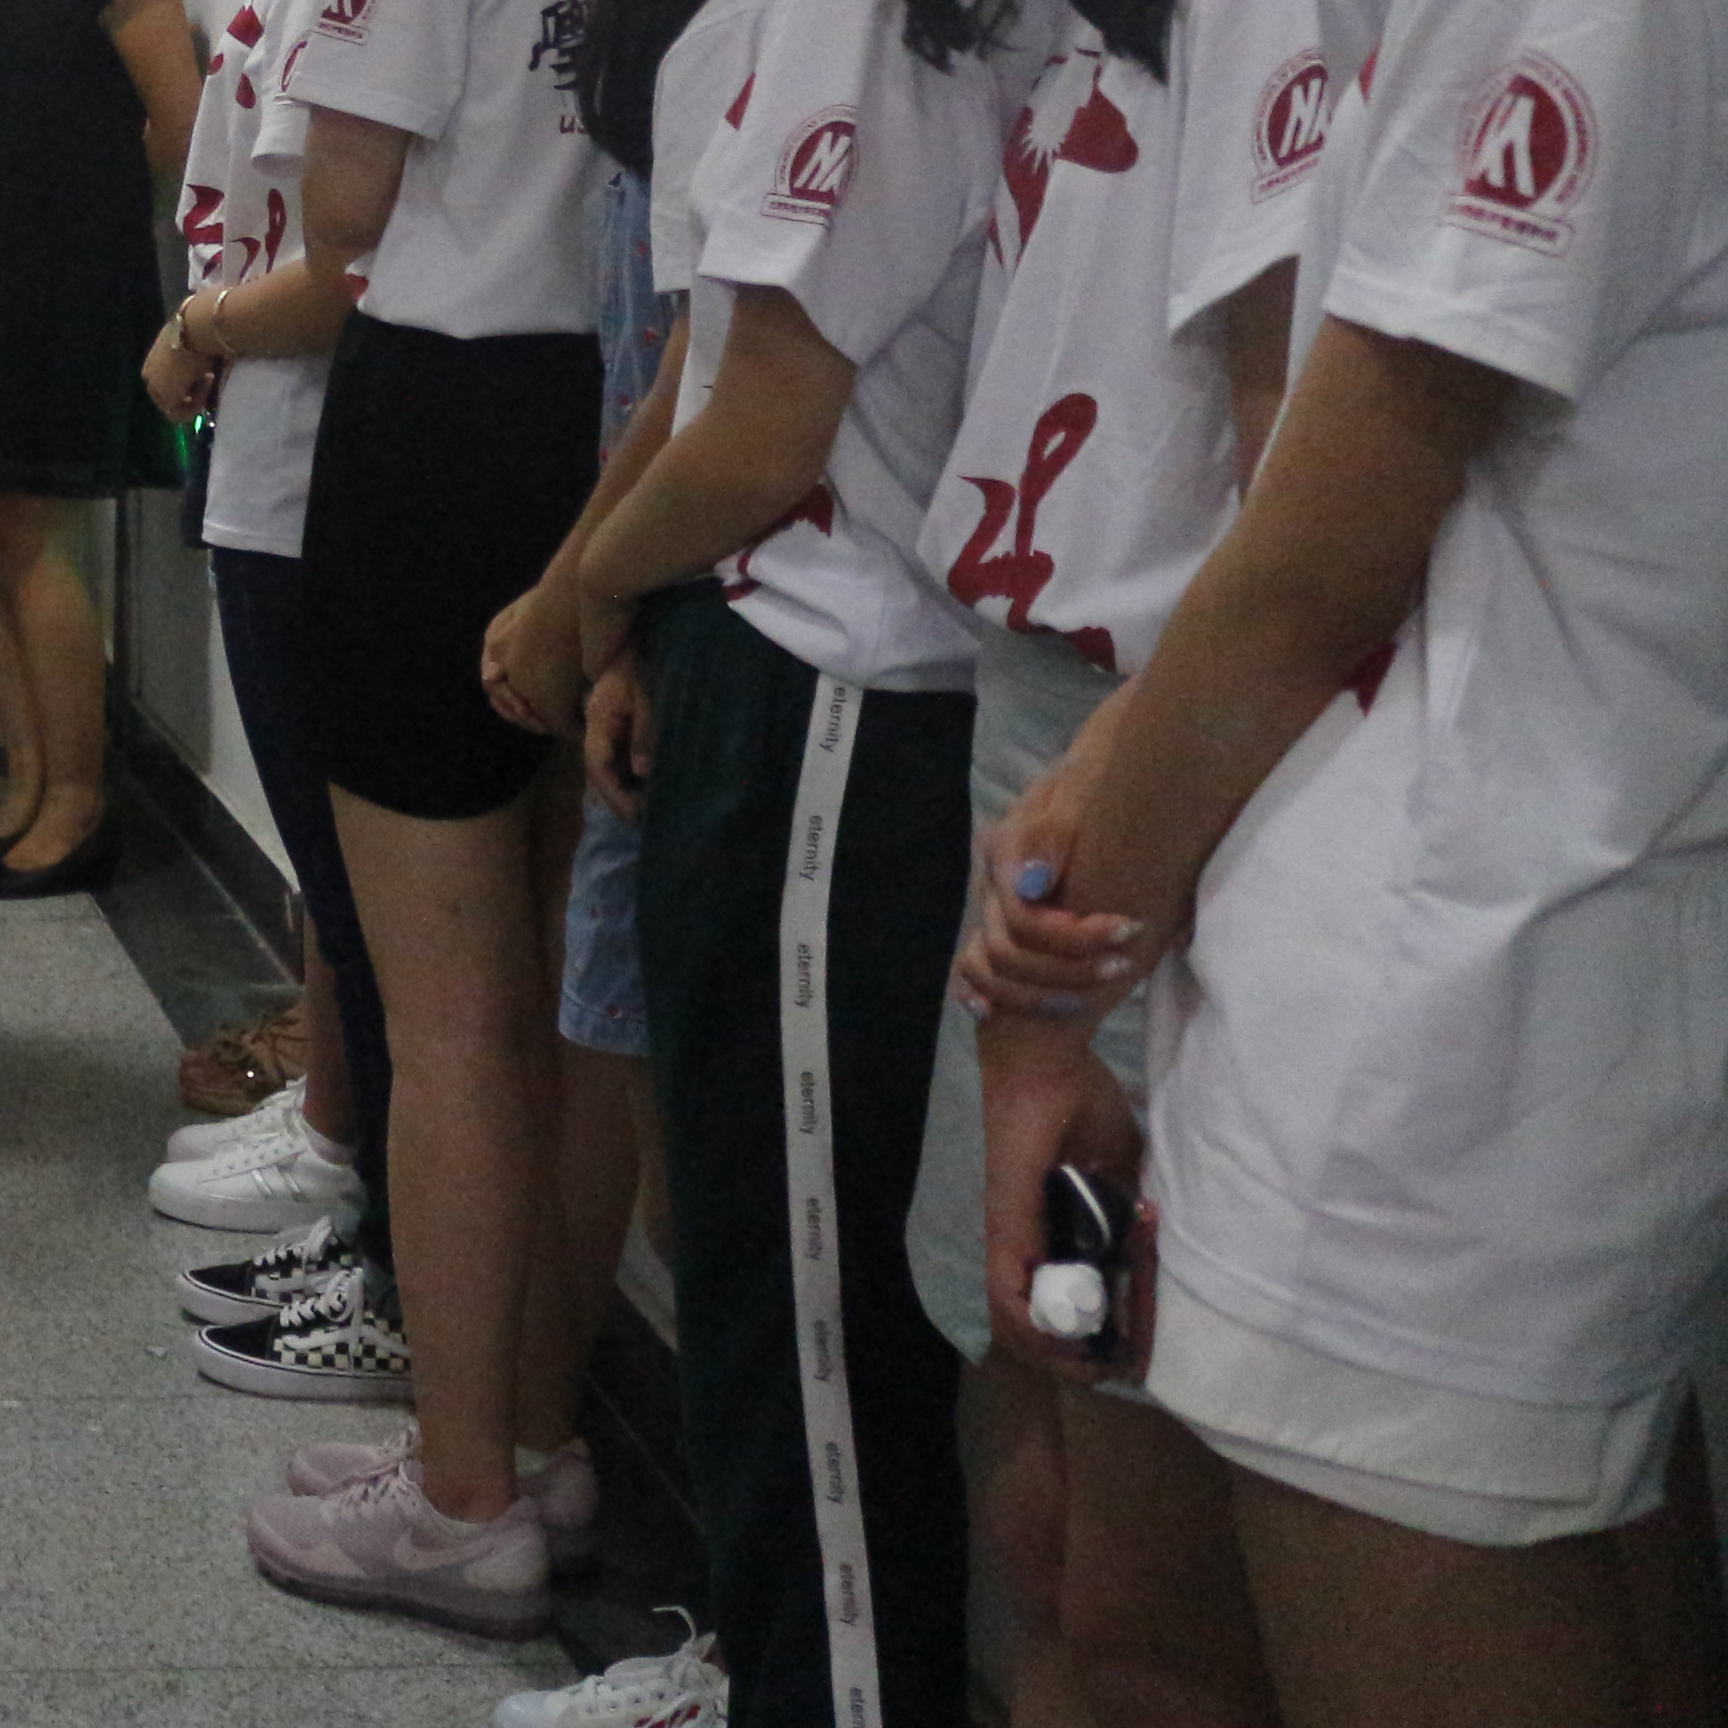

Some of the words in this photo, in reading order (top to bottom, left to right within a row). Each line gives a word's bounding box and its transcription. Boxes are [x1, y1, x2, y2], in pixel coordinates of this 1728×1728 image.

[820, 686, 846, 753] eternity
[799, 815, 823, 881] eternity
[794, 943, 813, 1008] eternity
[799, 1071, 817, 1134] eternity
[804, 1197, 823, 1260] eternity
